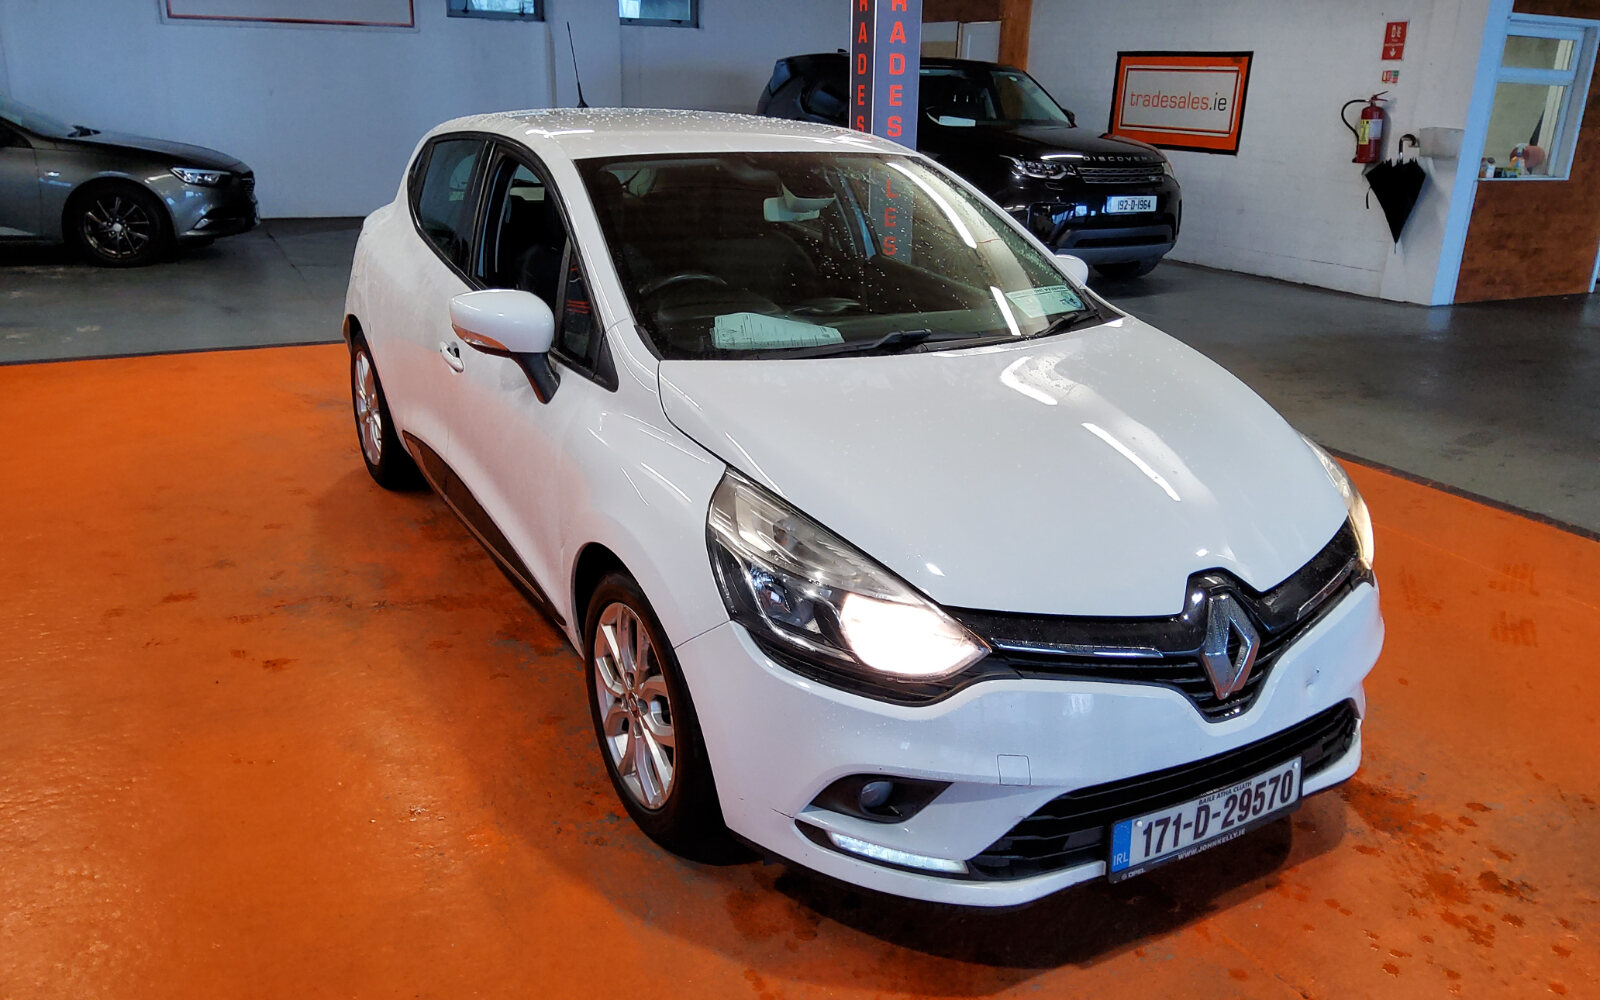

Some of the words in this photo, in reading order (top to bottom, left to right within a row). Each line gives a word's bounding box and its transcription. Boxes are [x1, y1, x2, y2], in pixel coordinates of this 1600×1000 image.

[1130, 90, 1227, 112] tradesales.ie
[1117, 199, 1151, 211] 192-D-1964
[1143, 769, 1293, 858] 171-D-29570
[1113, 852, 1129, 867] IRL
[1128, 868, 1146, 878] OPEL
